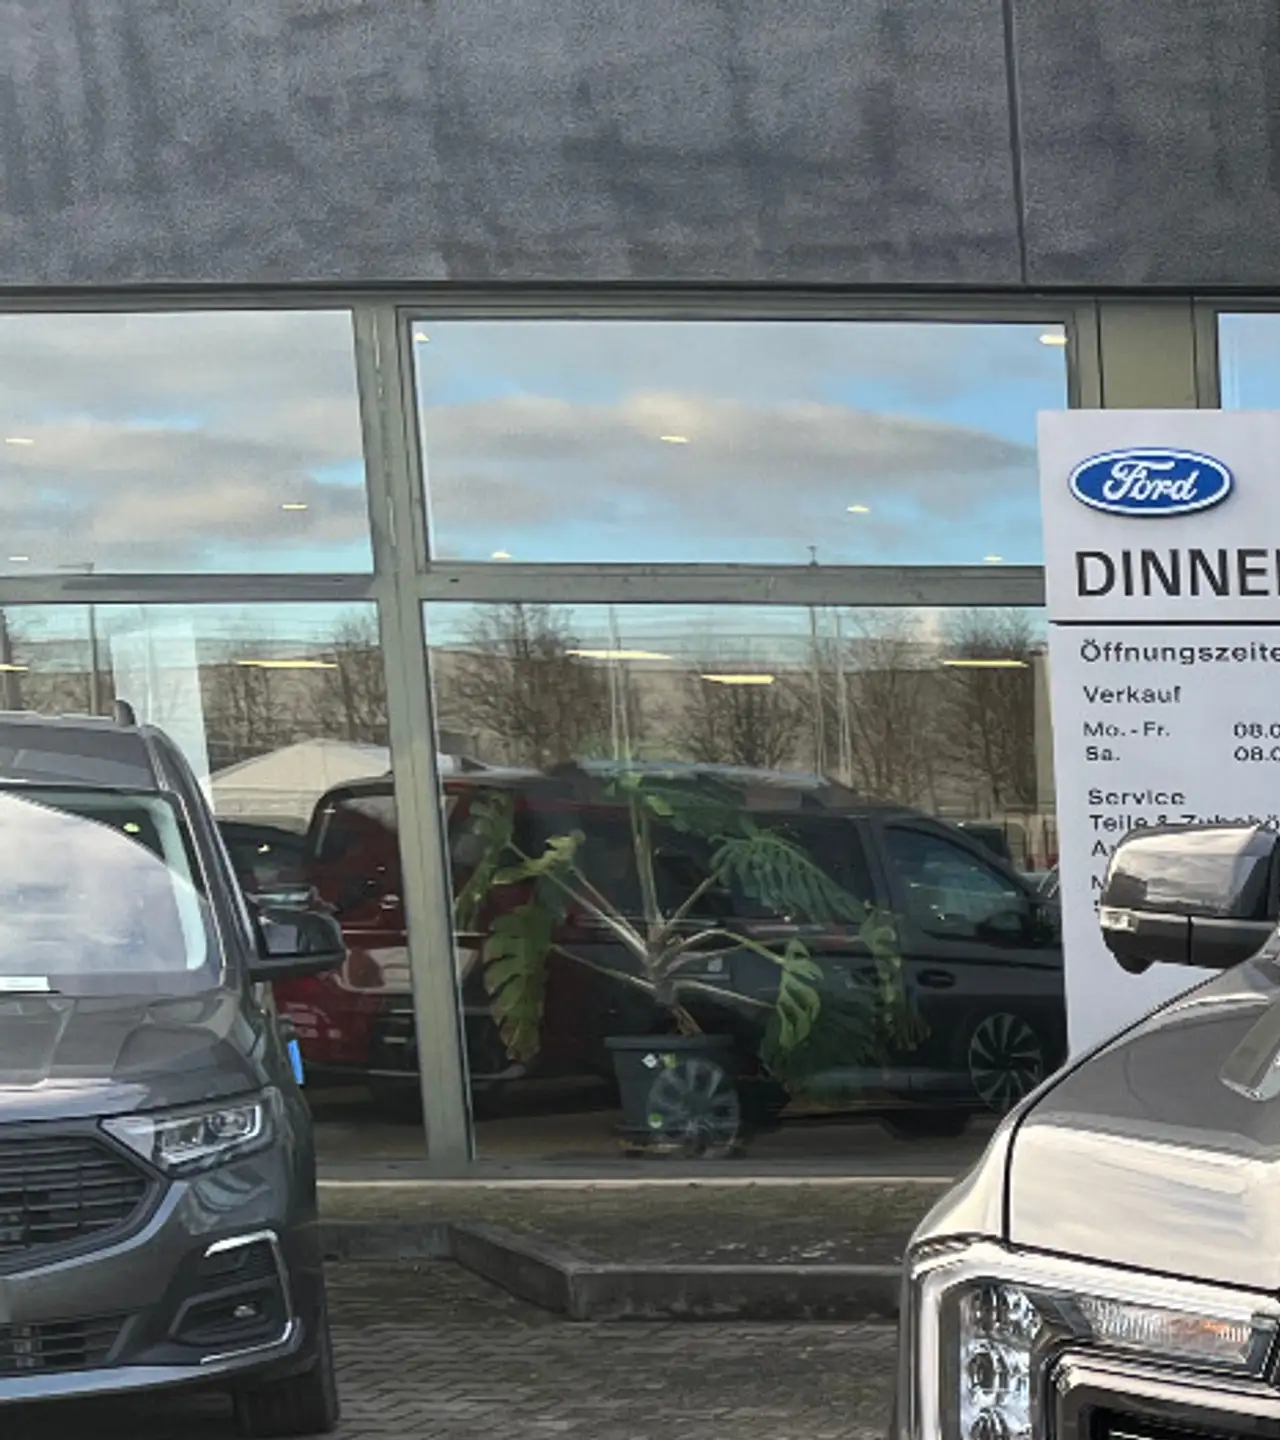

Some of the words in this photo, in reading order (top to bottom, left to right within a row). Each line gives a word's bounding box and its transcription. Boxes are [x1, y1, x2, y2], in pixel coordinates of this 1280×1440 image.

[1102, 458, 1199, 502] Ford
[1083, 686, 1182, 704] Verkauf
[1085, 746, 1121, 762] Sa.
[1087, 788, 1186, 806] Service
[1089, 814, 1148, 833] Teile
